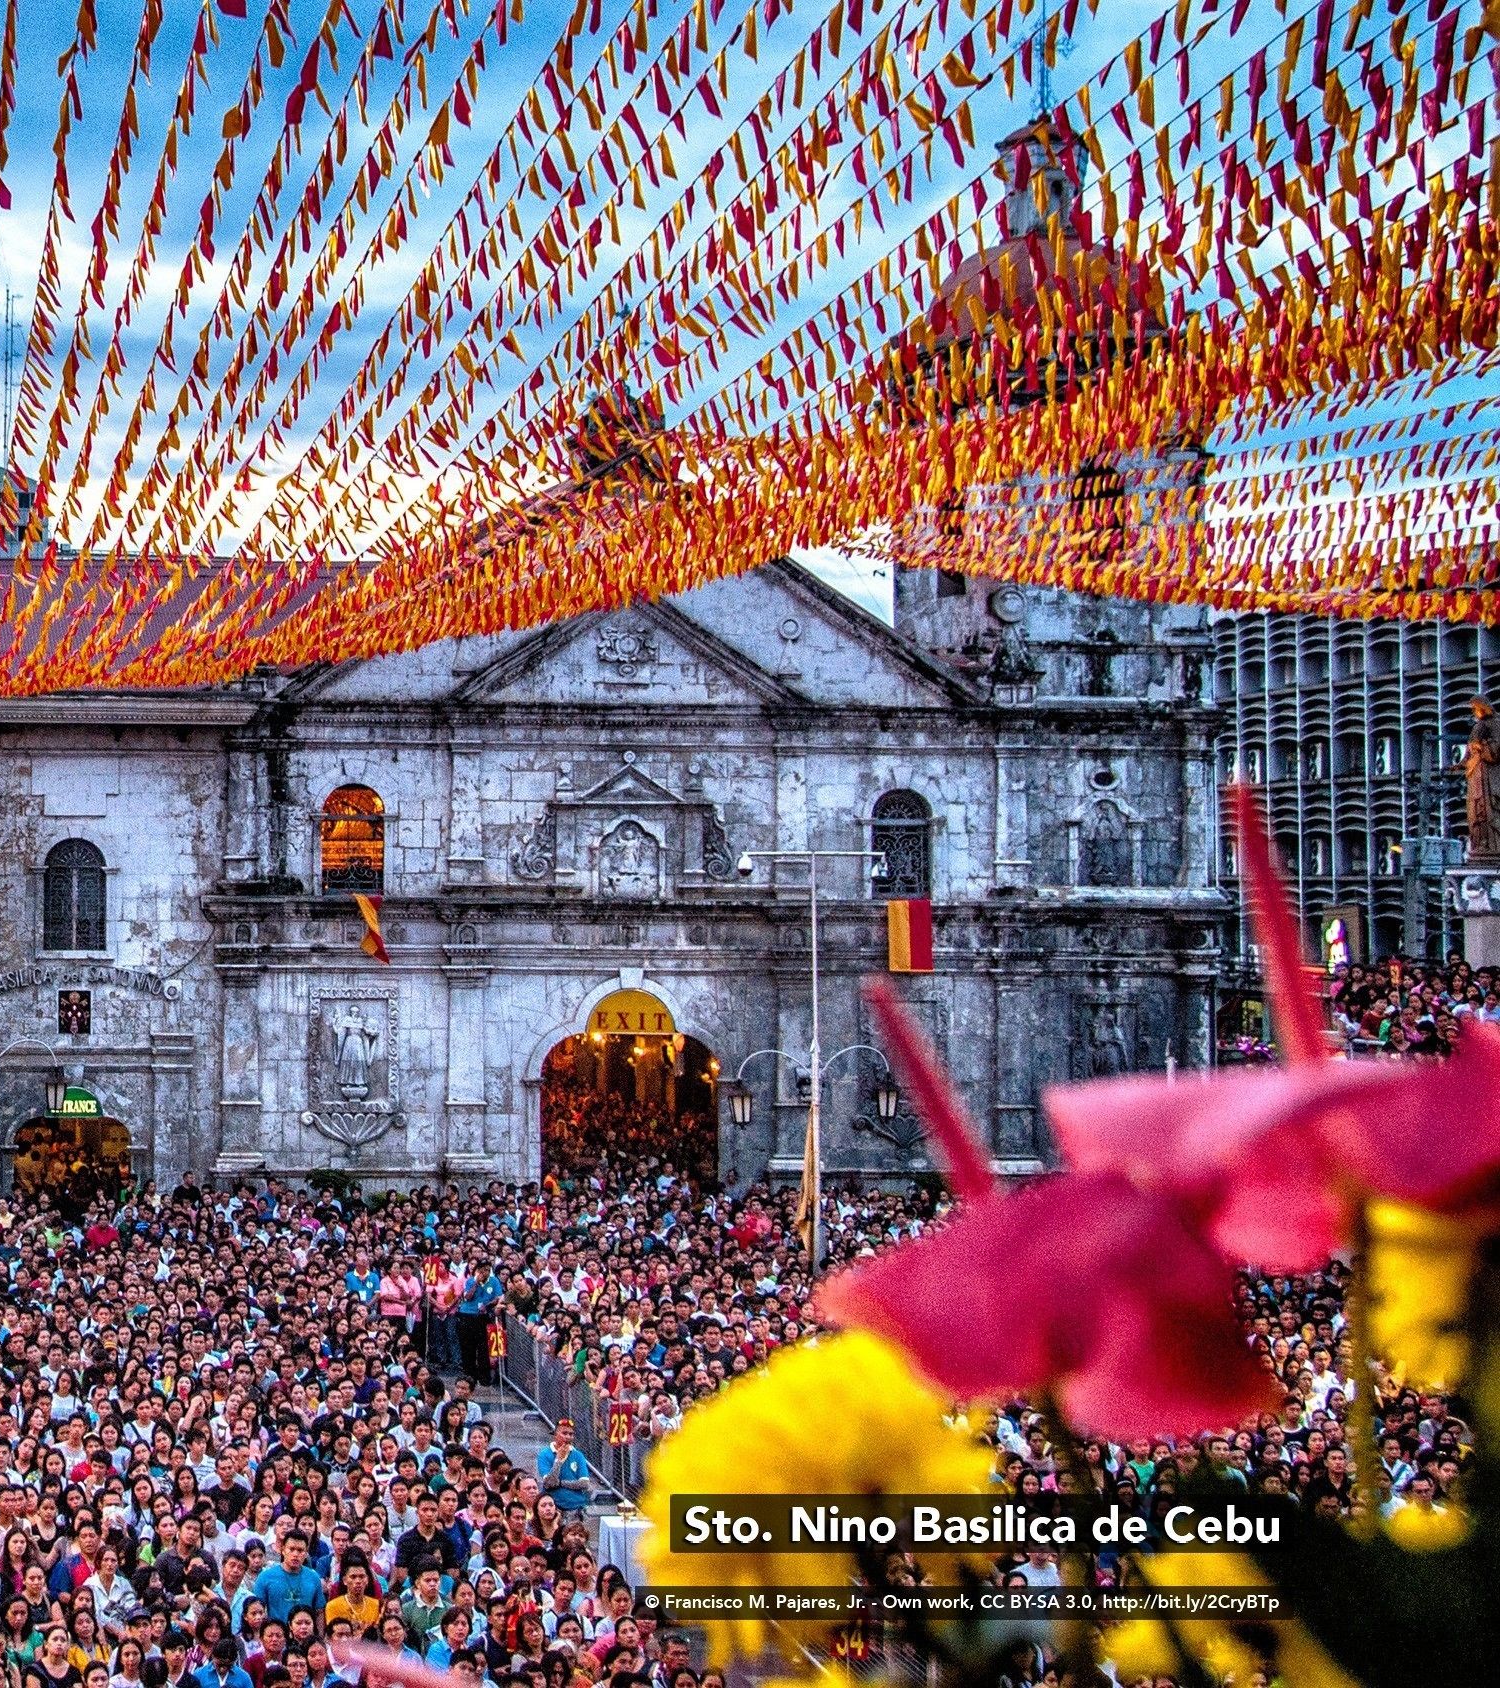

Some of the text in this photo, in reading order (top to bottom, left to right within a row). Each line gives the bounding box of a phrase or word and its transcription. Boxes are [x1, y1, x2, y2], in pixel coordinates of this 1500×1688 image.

[596, 1011, 668, 1031] EXIT
[50, 1099, 97, 1114] TRANCE
[530, 1209, 544, 1230] 21
[424, 1262, 437, 1285] 24
[610, 1413, 628, 1443] 26
[835, 1630, 864, 1657] 34
